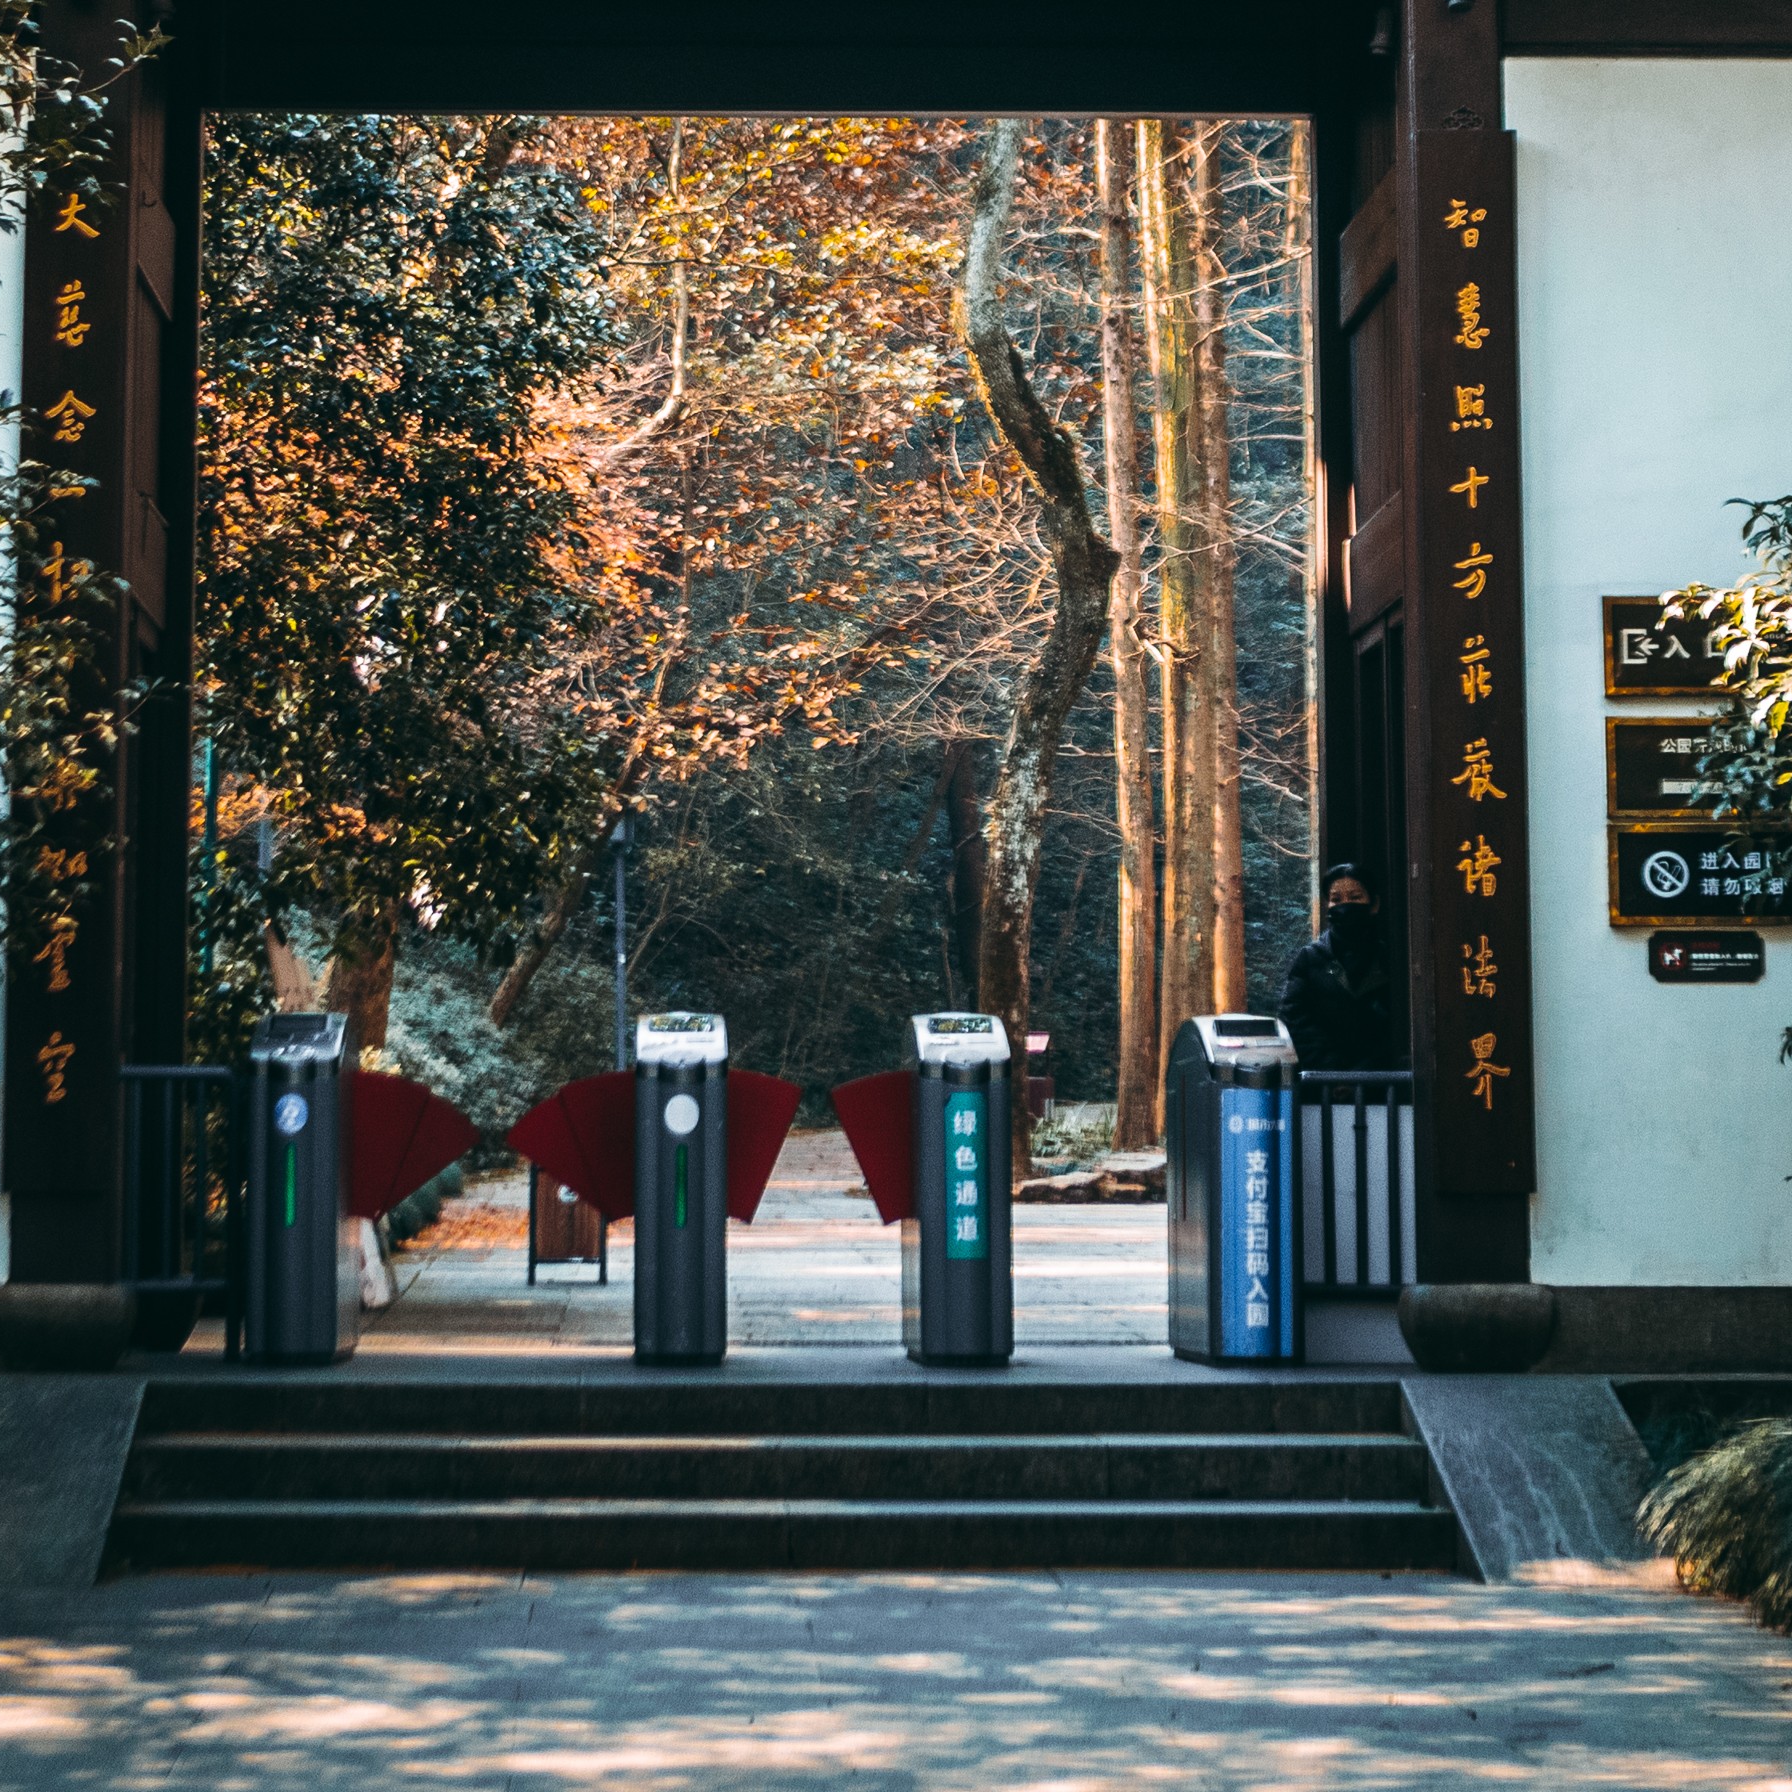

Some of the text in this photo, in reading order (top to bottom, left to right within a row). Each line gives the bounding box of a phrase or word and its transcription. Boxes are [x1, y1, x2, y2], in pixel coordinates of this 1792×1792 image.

[953, 1110, 978, 1241] 绿色通道
[1245, 1148, 1270, 1327] 支付宝扫码入园
